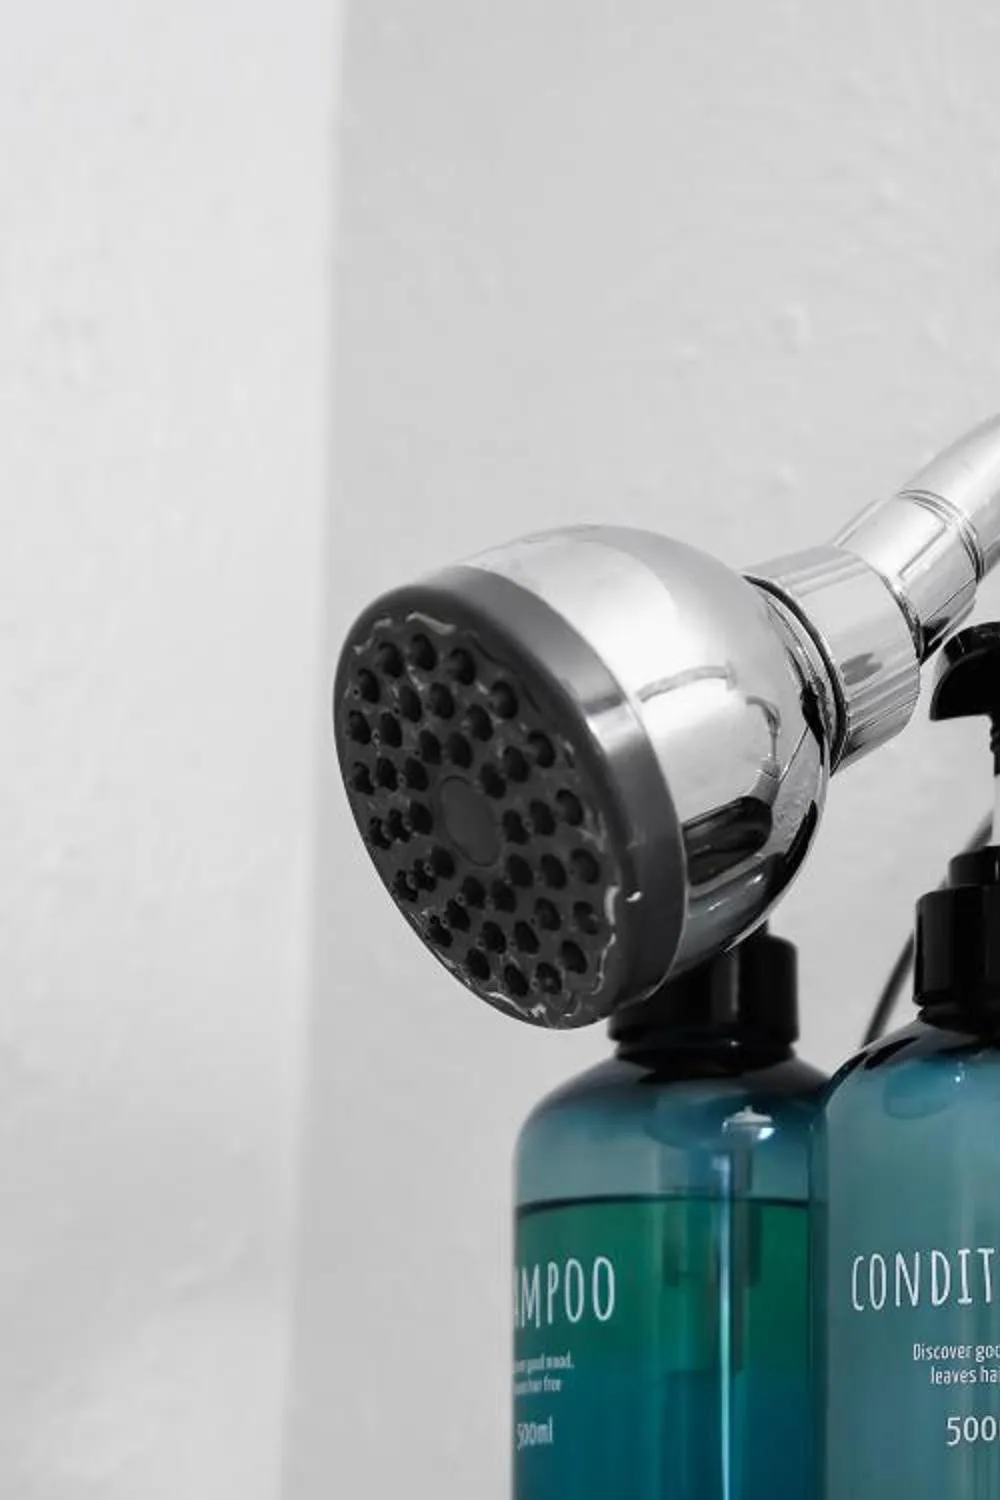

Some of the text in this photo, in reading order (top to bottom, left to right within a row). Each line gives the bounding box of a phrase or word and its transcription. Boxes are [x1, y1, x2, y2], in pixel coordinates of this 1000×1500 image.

[912, 1343, 973, 1361] Discover
[931, 1366, 977, 1385] leaves
[517, 1416, 553, 1450] 500ml
